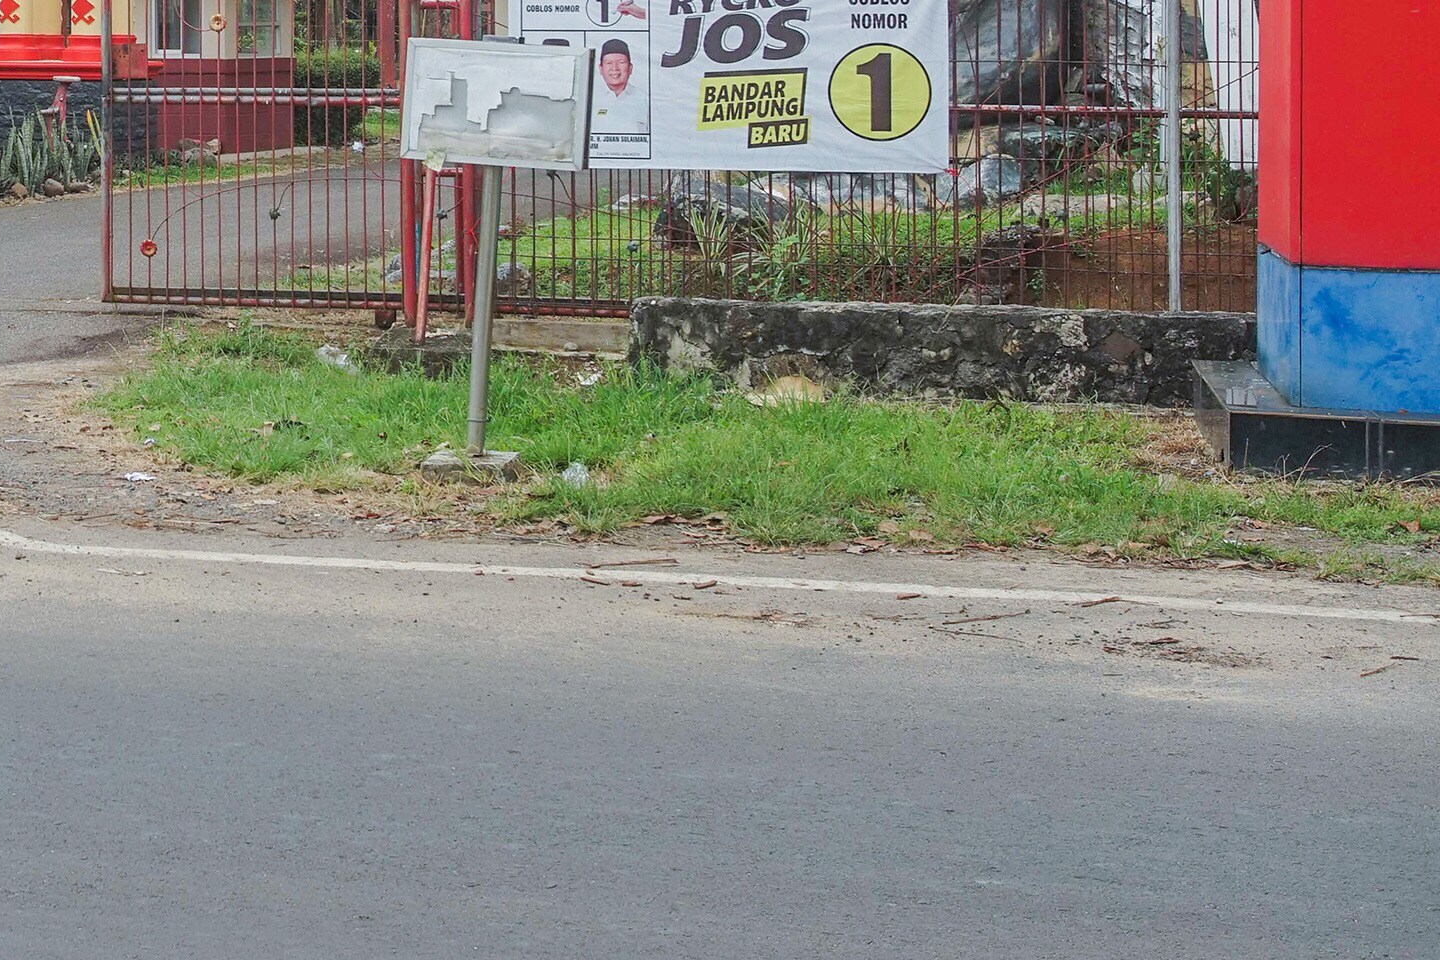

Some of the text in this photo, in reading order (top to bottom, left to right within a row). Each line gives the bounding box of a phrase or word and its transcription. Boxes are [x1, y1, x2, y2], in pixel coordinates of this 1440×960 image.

[525, 4, 553, 13] COBLOS
[554, 4, 580, 13] NOMOR
[850, 12, 908, 30] NOMOR
[660, 6, 812, 68] JOS
[703, 80, 786, 105] BANDAR
[856, 52, 892, 132] 1
[701, 97, 799, 123] LAMPUNG
[749, 122, 806, 146] BARU
